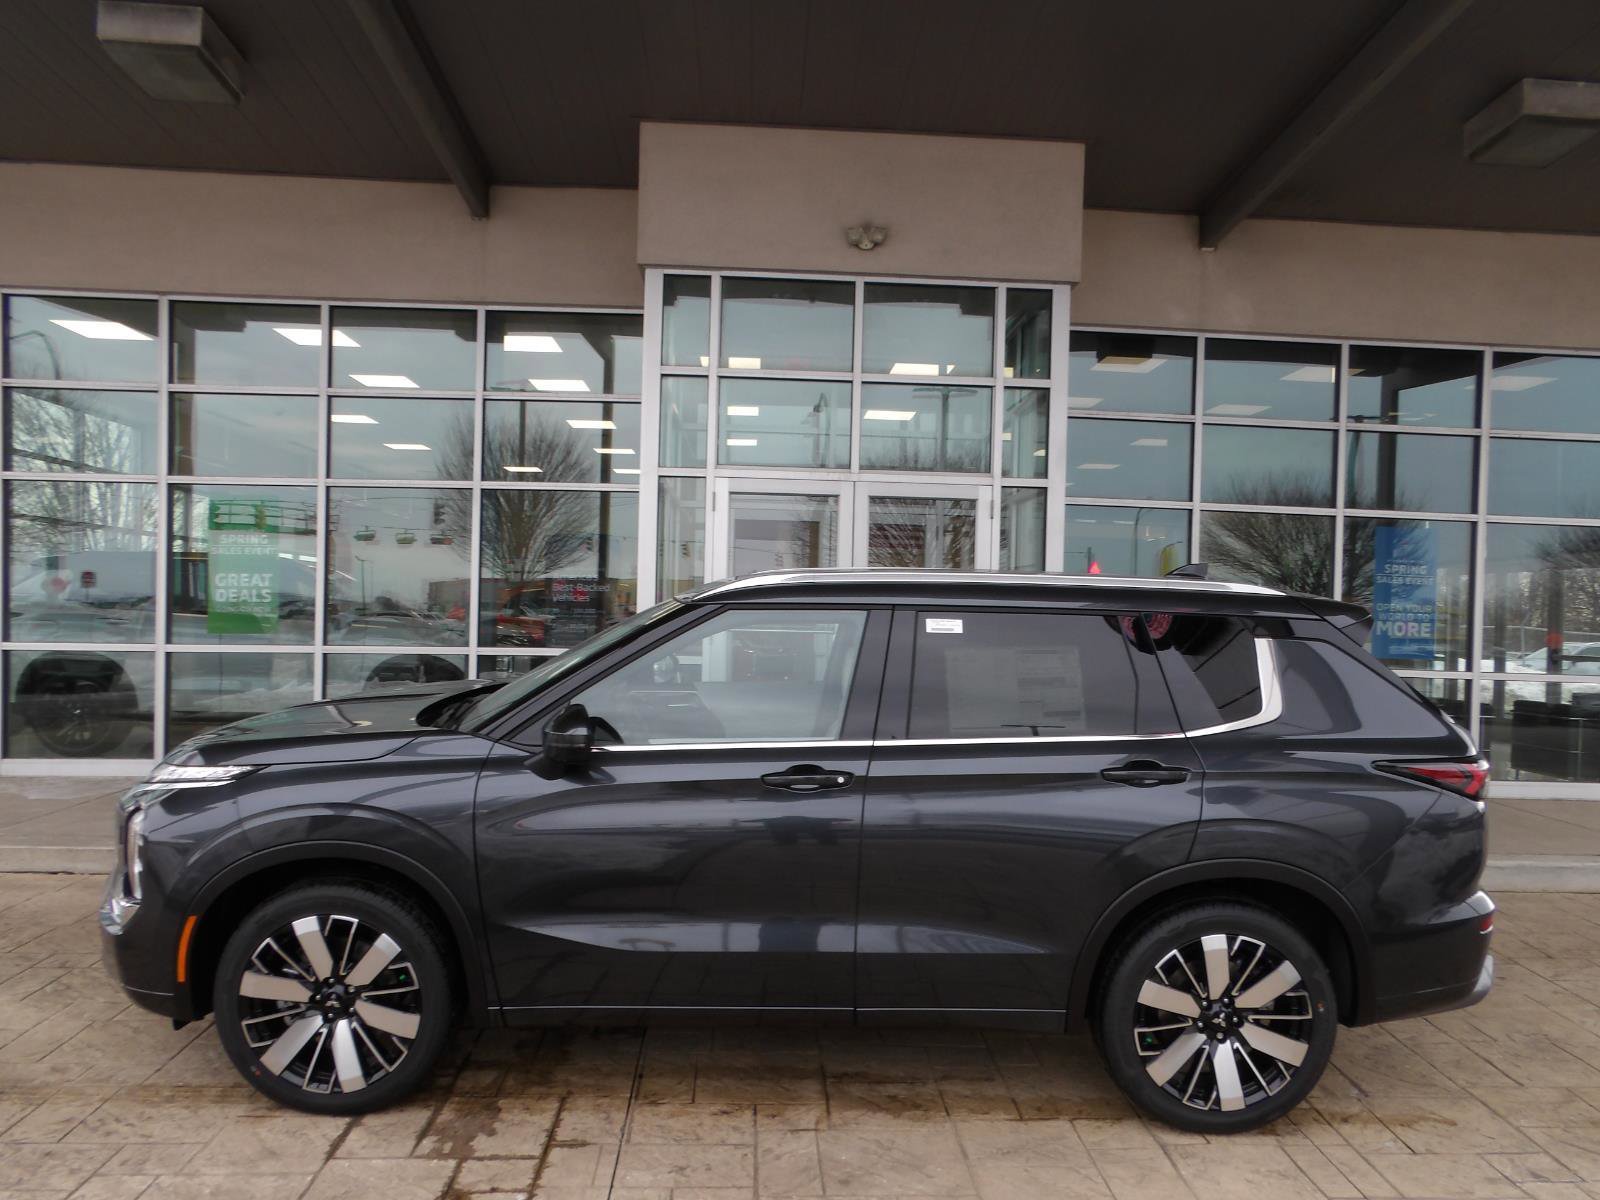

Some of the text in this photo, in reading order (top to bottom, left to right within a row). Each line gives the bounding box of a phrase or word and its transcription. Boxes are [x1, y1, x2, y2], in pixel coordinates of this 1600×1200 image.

[1384, 564, 1427, 575] SPRING
[215, 573, 272, 587] GREAT
[215, 589, 272, 603] DEALS
[1375, 621, 1432, 638] MORE
